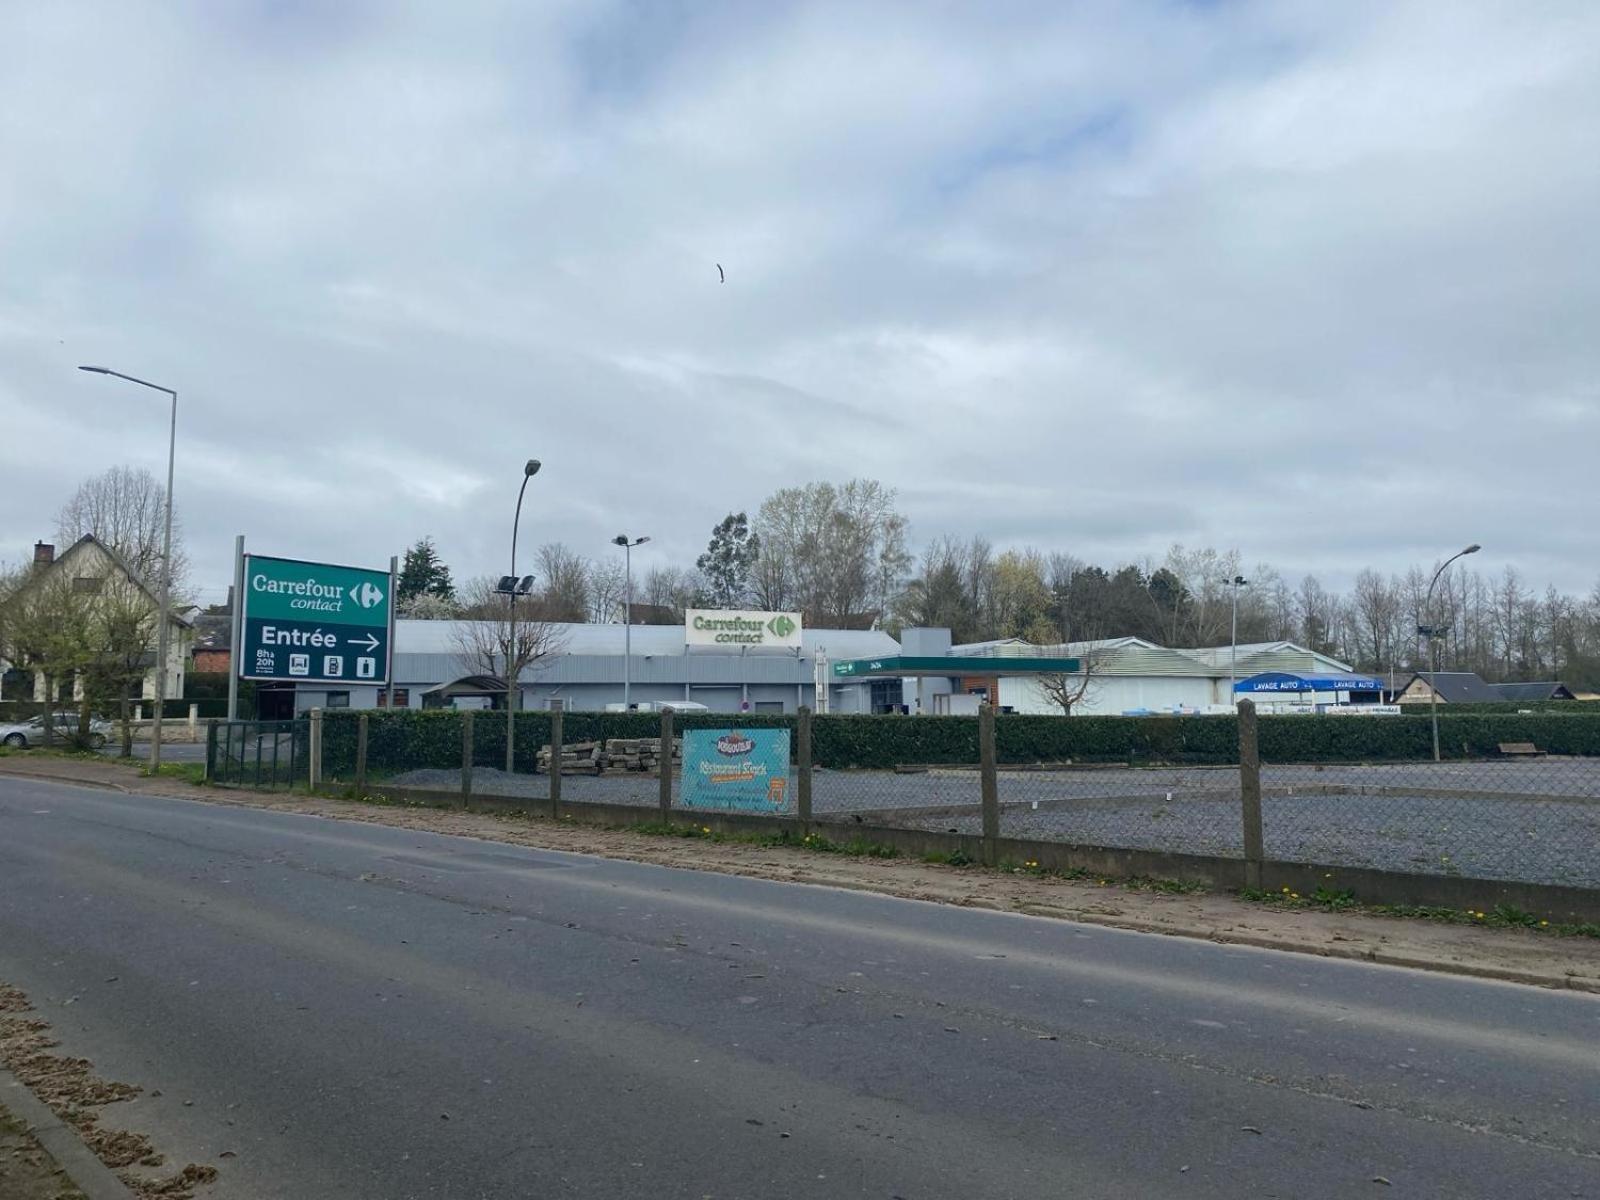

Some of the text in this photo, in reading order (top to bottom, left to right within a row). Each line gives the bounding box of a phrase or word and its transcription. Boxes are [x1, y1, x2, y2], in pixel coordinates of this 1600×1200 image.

[253, 574, 344, 599] Carrefour
[290, 598, 343, 612] contact
[693, 616, 765, 631] Carrefour
[262, 626, 337, 648] Entrée
[715, 632, 764, 644] contact
[256, 658, 275, 667] 20h
[1280, 681, 1298, 689] AUTO
[1333, 681, 1375, 689] LAVAGE AUTO
